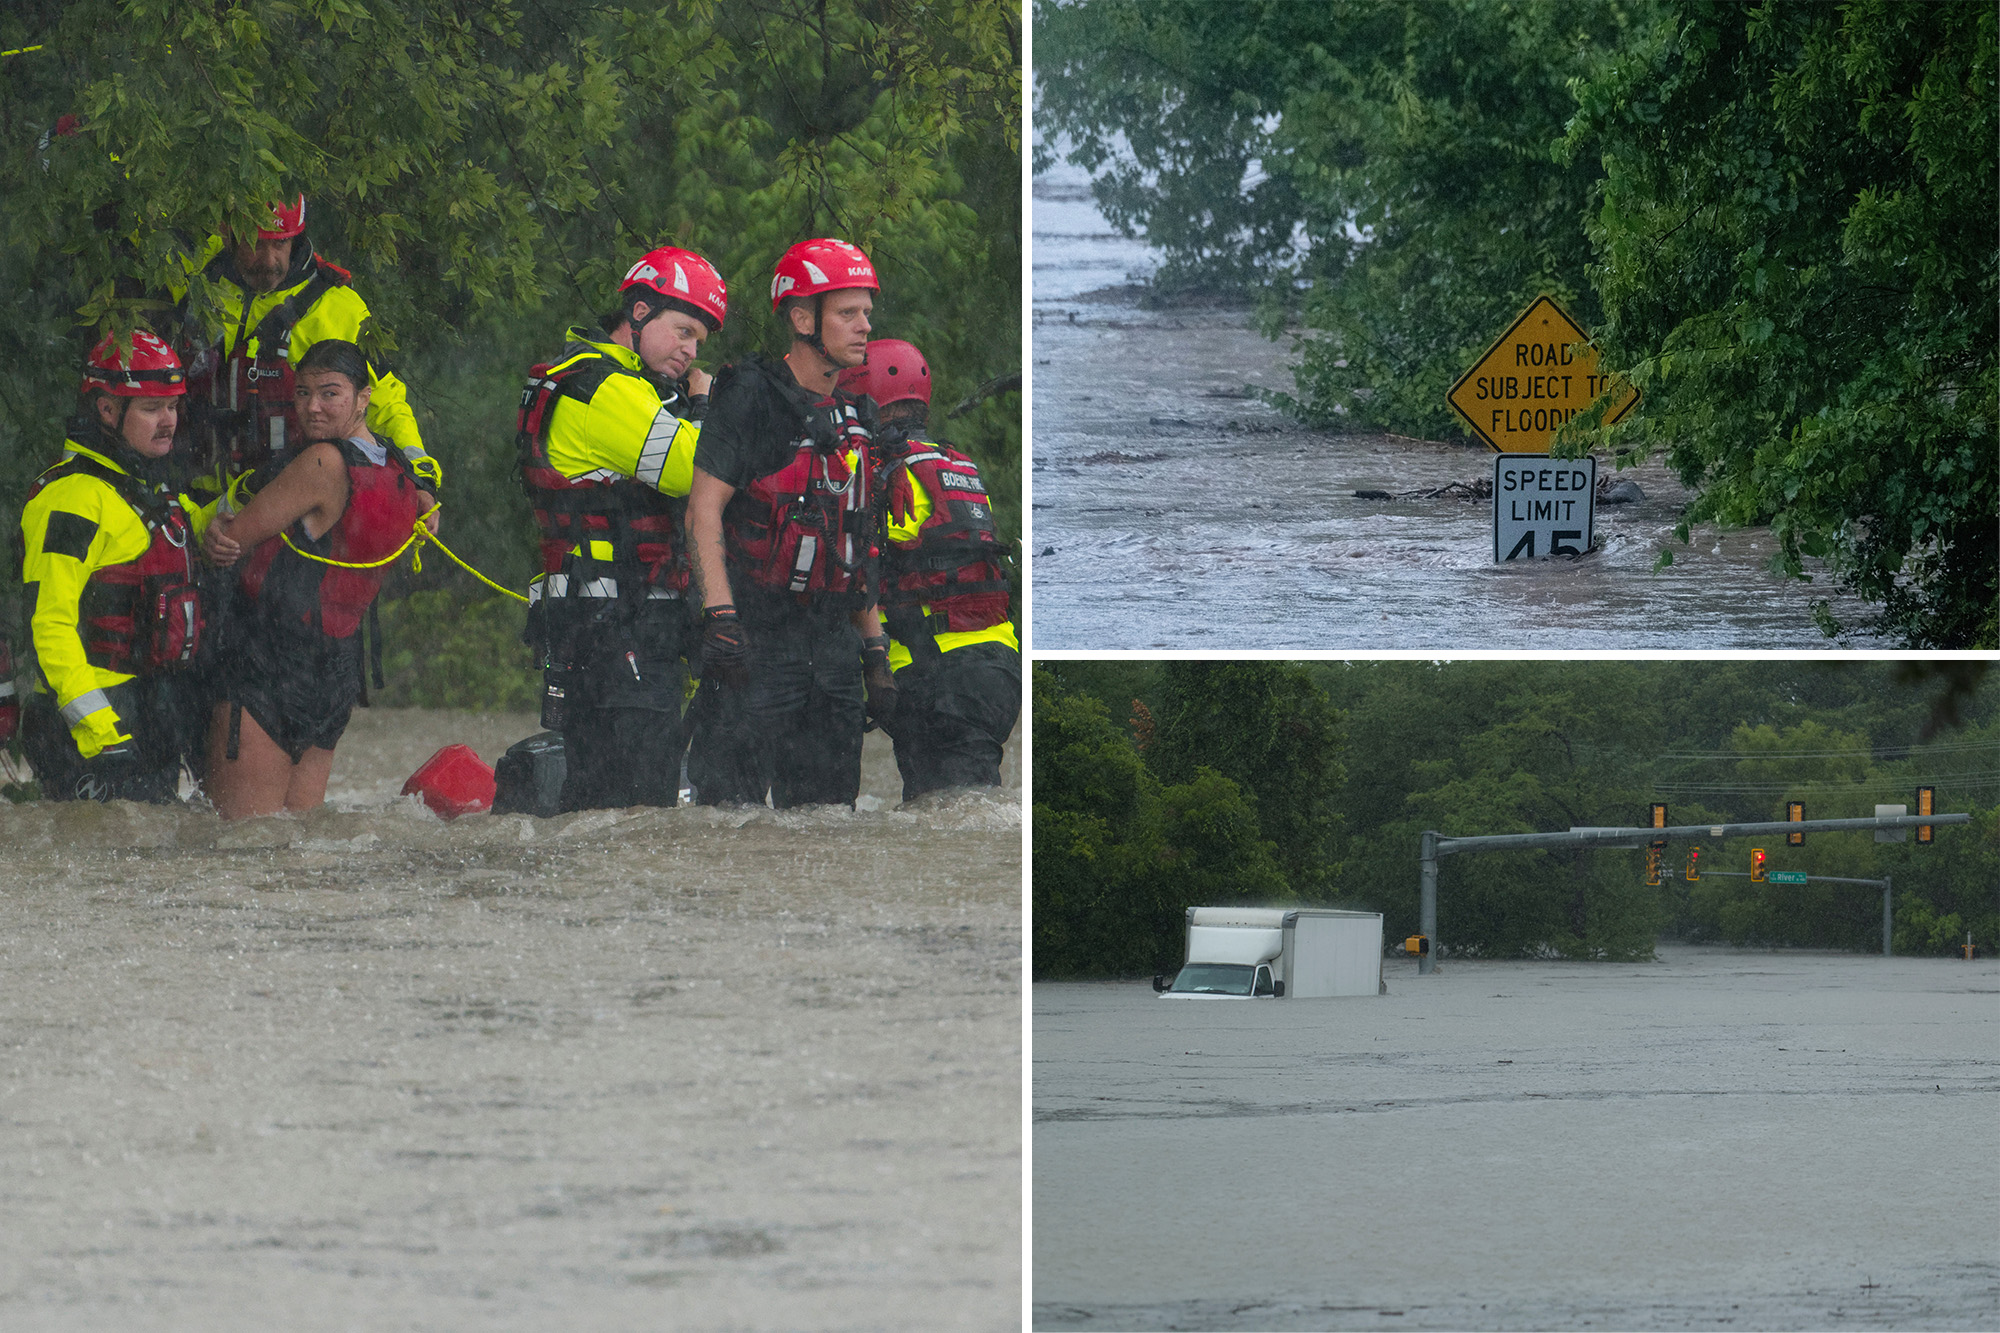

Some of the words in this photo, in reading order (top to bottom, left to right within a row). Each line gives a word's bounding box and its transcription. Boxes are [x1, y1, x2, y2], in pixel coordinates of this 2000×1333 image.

[1516, 343, 1573, 366] ROAD
[1476, 375, 1573, 400] SUBJECT
[1492, 408, 1584, 432] FLOODI
[1503, 469, 1587, 491] SPEED
[1512, 500, 1576, 521] LIMIT
[1777, 873, 1796, 881] River
